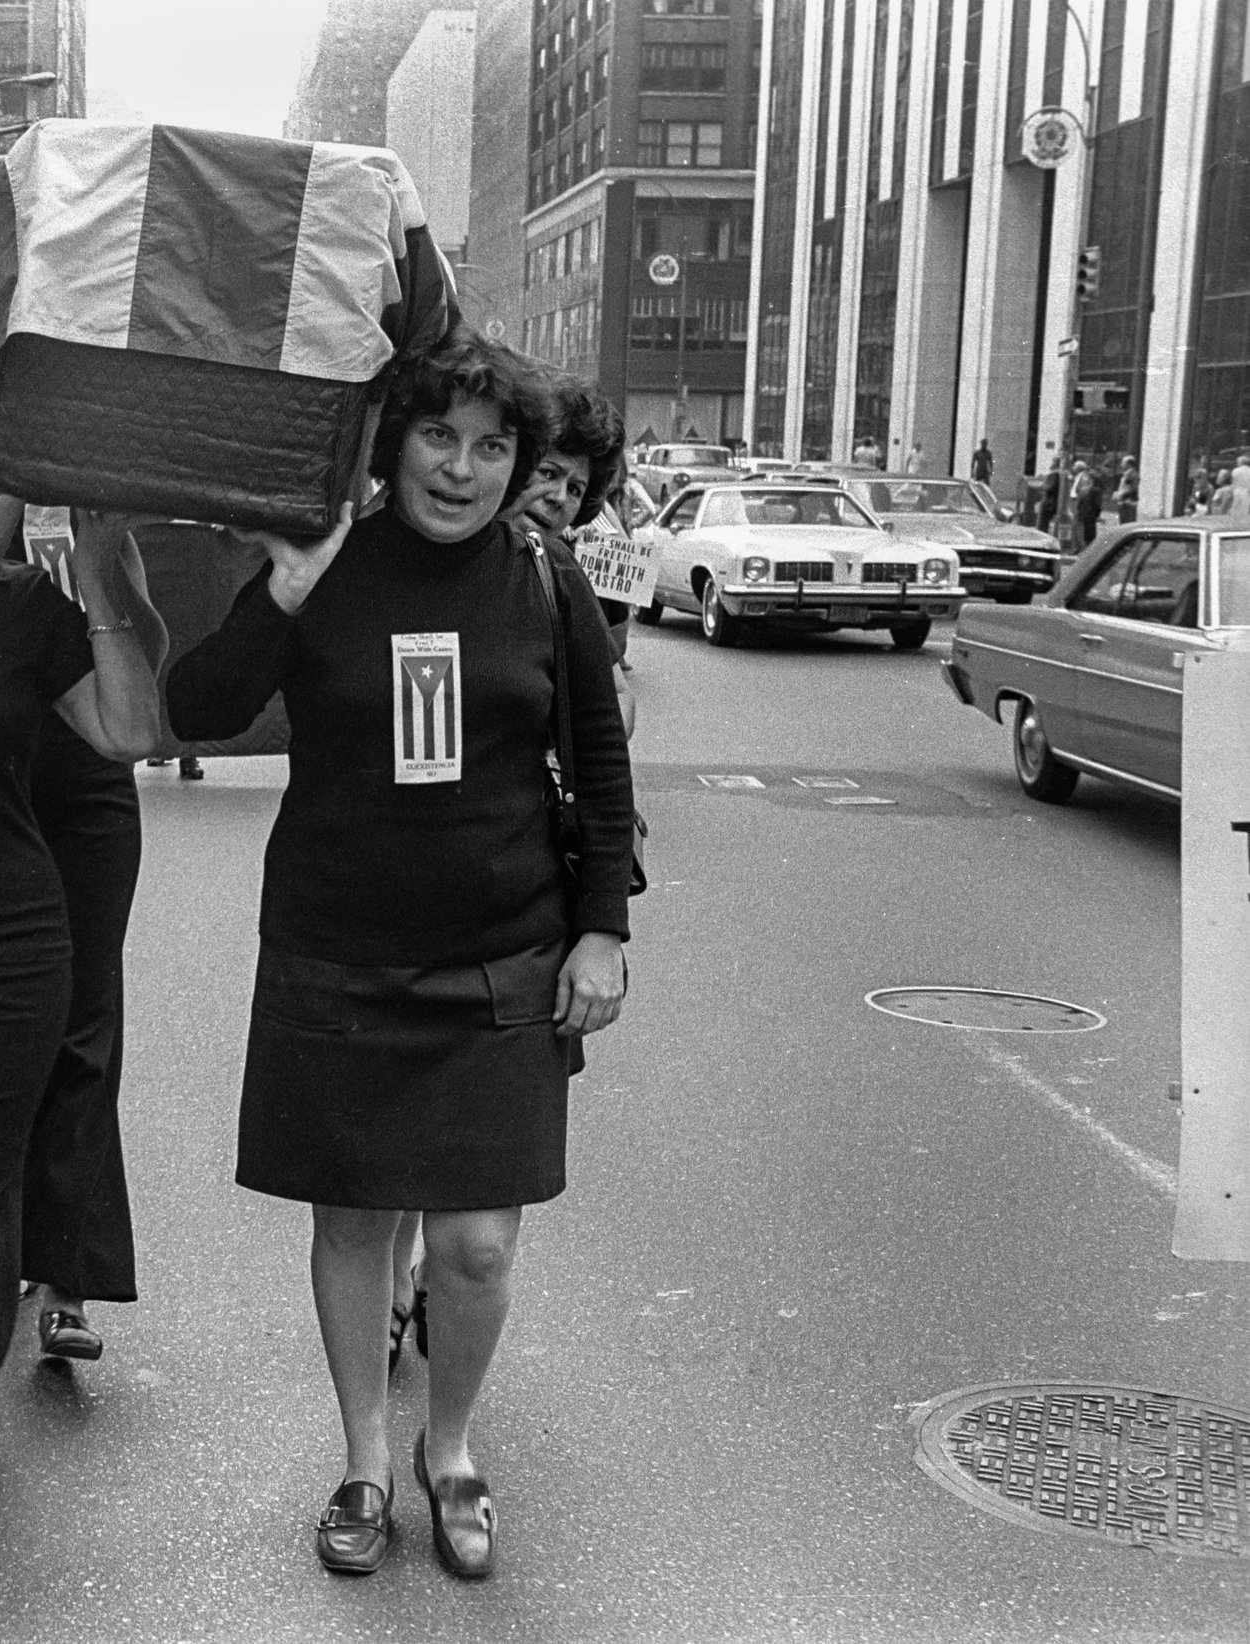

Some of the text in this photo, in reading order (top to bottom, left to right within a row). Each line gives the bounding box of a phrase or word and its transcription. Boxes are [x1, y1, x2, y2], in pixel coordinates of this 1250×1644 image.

[610, 540, 636, 554] SHALL
[639, 546, 652, 558] BE
[580, 553, 645, 582] DOWN WITH
